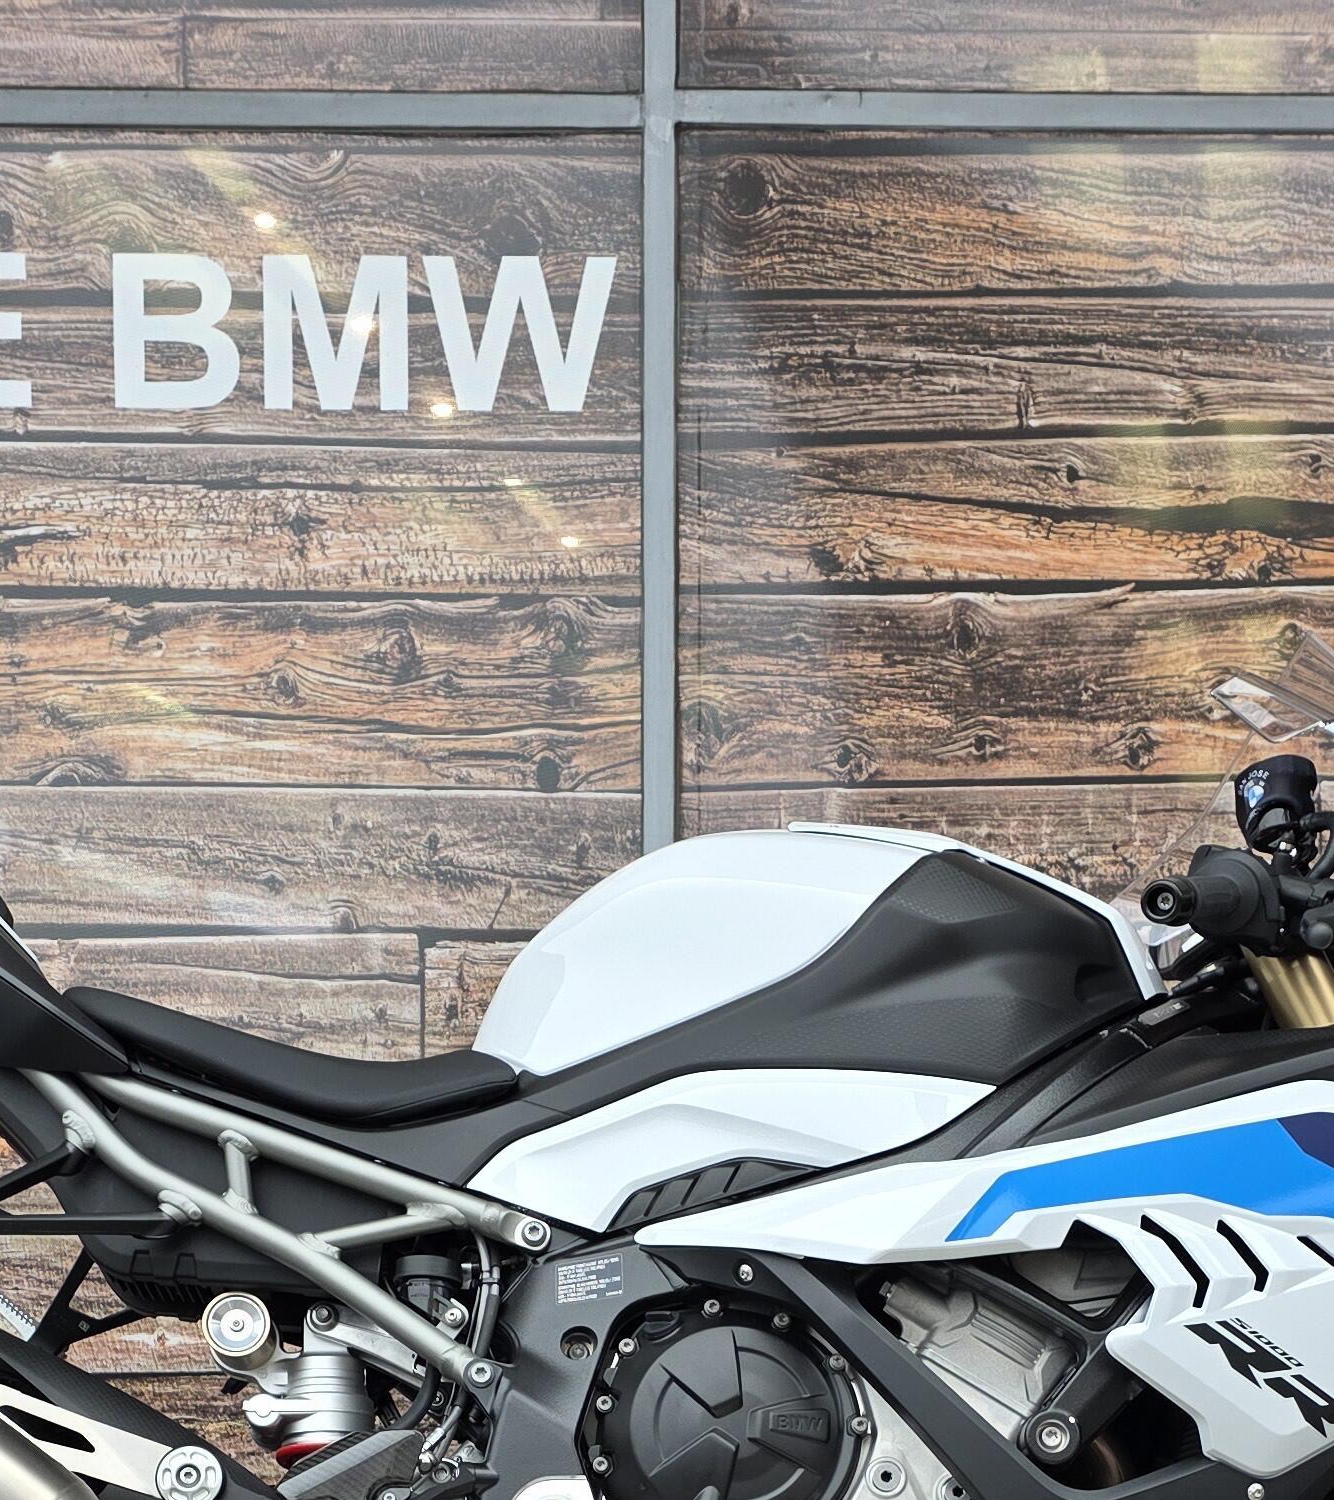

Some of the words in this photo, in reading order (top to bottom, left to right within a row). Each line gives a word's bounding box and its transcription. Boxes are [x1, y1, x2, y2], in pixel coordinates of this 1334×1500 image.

[113, 252, 617, 413] BMW
[1248, 769, 1270, 780] JOSE
[1229, 1317, 1305, 1367] S1000
[778, 1414, 823, 1433] BMW
